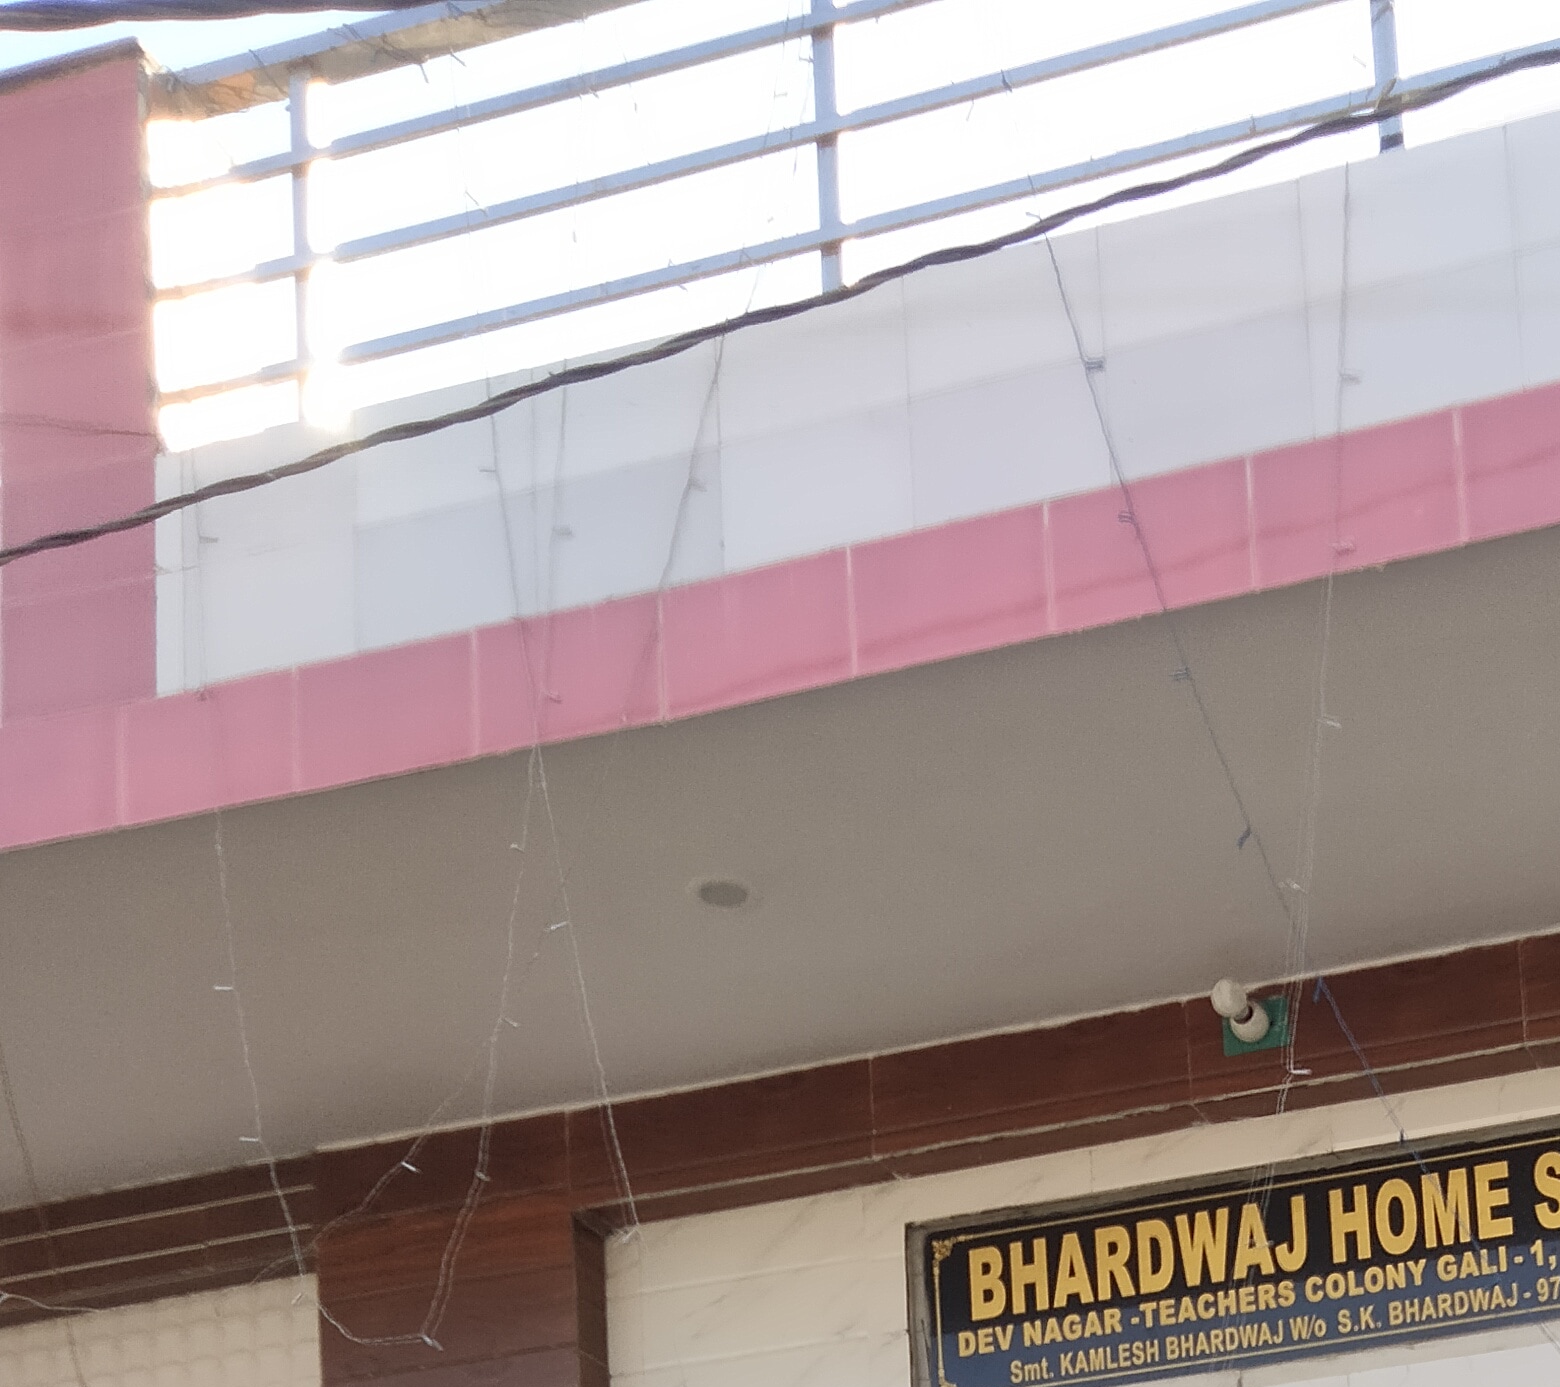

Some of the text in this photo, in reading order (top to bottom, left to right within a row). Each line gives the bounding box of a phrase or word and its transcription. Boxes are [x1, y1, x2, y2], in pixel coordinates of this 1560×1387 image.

[968, 1194, 1307, 1322] BHARDWAJ
[1328, 1160, 1514, 1264] HOME
[957, 1324, 1014, 1358] DEV
[1022, 1307, 1123, 1348] NAGAR
[1304, 1258, 1427, 1303] COLONY
[1436, 1246, 1508, 1282] GALI
[1009, 1356, 1055, 1384] Smt.
[1060, 1338, 1159, 1377] KAMLESH
[1164, 1319, 1284, 1361] BHARDWAJ
[1289, 1313, 1327, 1341] W/o
[1337, 1304, 1382, 1334] S.K.
[1387, 1282, 1519, 1327] BHARDWAJ
